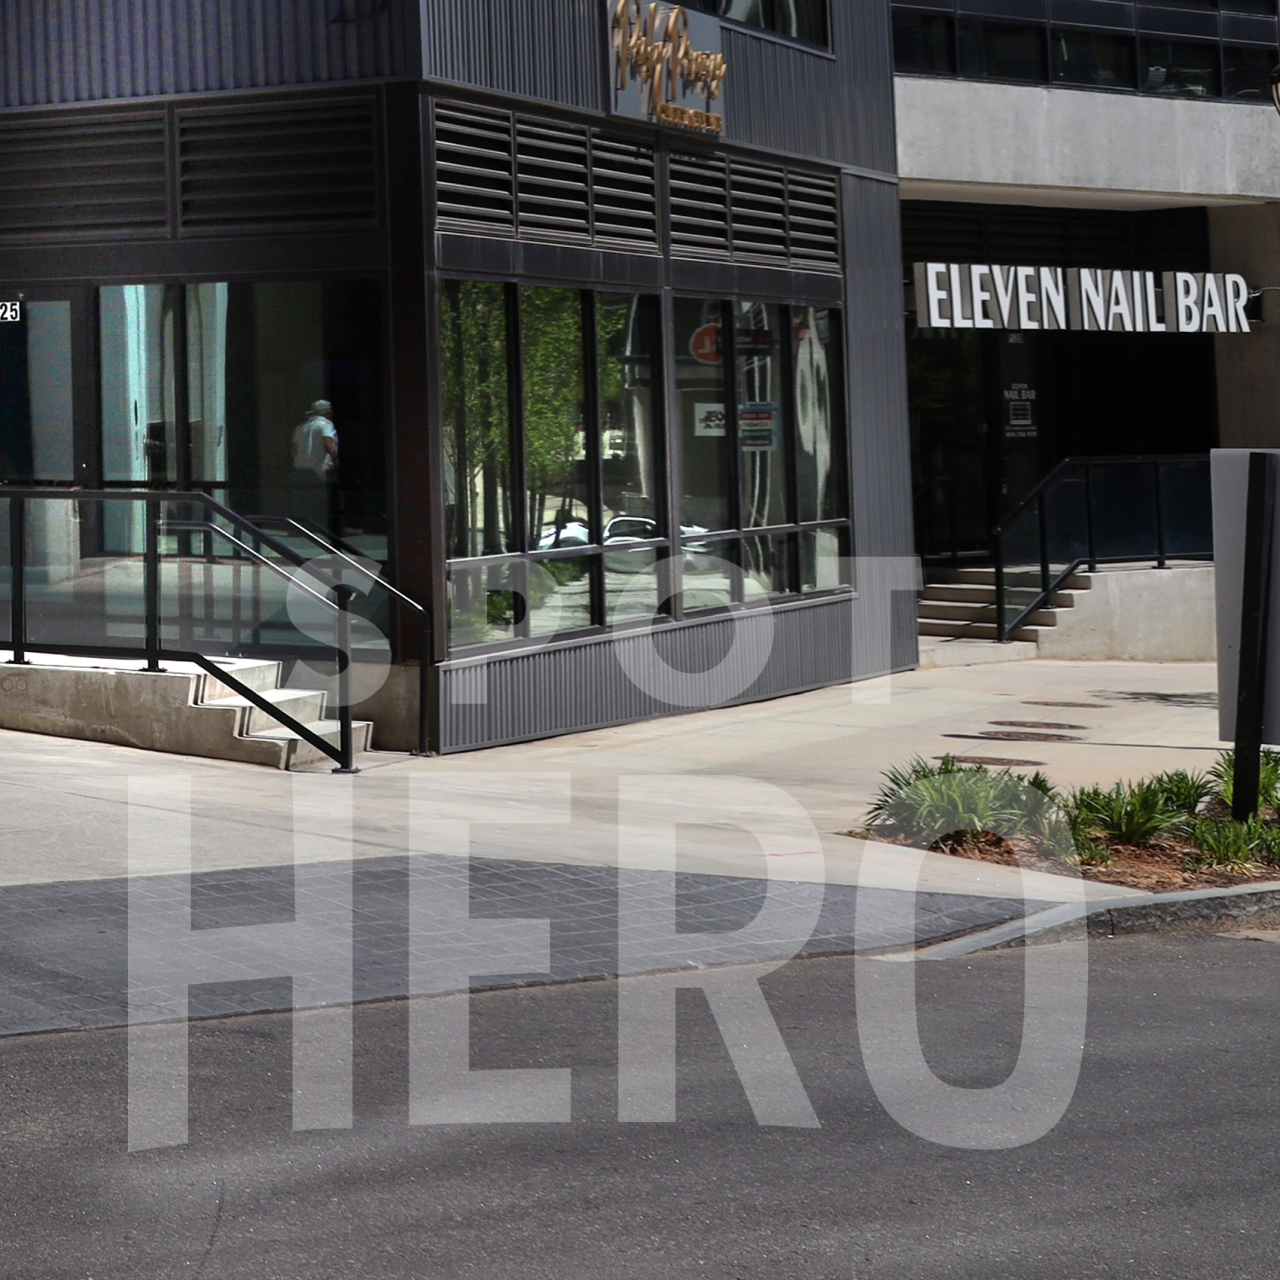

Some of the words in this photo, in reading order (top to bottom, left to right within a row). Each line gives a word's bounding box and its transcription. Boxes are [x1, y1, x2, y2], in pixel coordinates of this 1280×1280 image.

[926, 262, 1067, 330] ELEVEN
[1079, 267, 1166, 332] NAIL
[1175, 271, 1251, 333] BAR
[1004, 390, 1020, 399] NAIL
[1021, 390, 1036, 399] BAR
